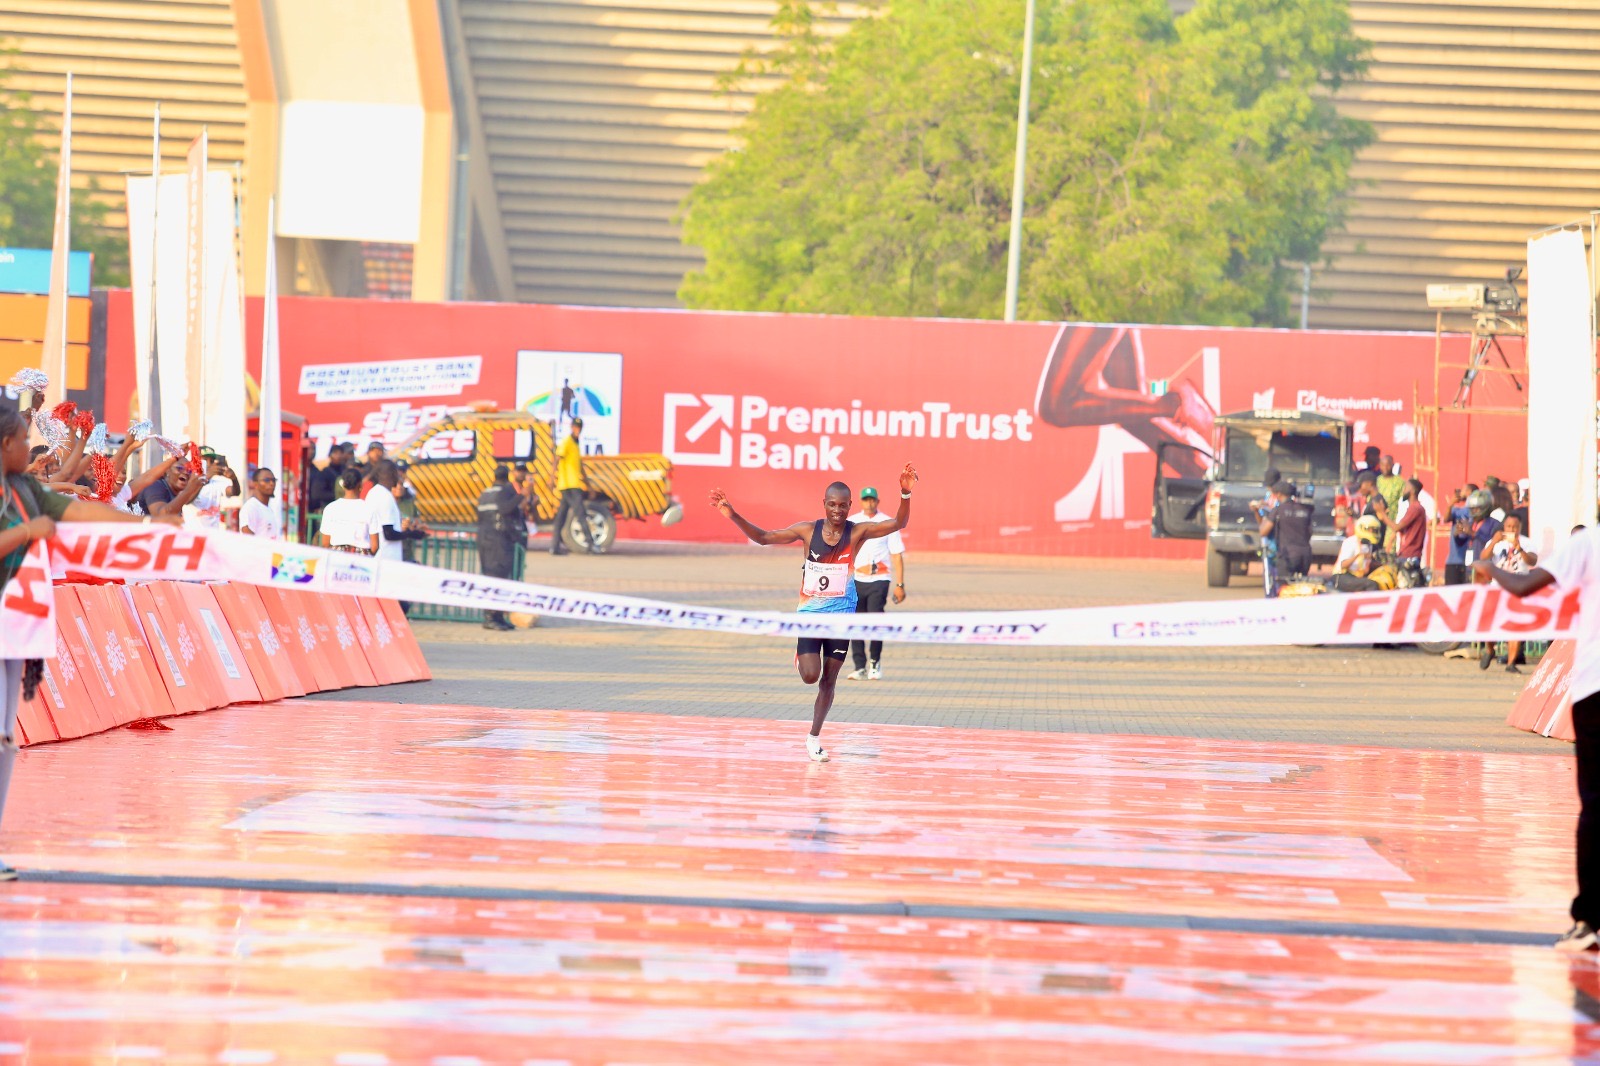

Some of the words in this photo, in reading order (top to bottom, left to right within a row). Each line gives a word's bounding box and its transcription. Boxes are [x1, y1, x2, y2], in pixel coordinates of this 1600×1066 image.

[1317, 396, 1403, 411] PremiumTrust
[741, 395, 1033, 442] PremiumTrust
[740, 433, 845, 471] Bank
[818, 575, 830, 592] 9
[973, 623, 1048, 634] CITY
[1150, 616, 1286, 629] PremiumTrust
